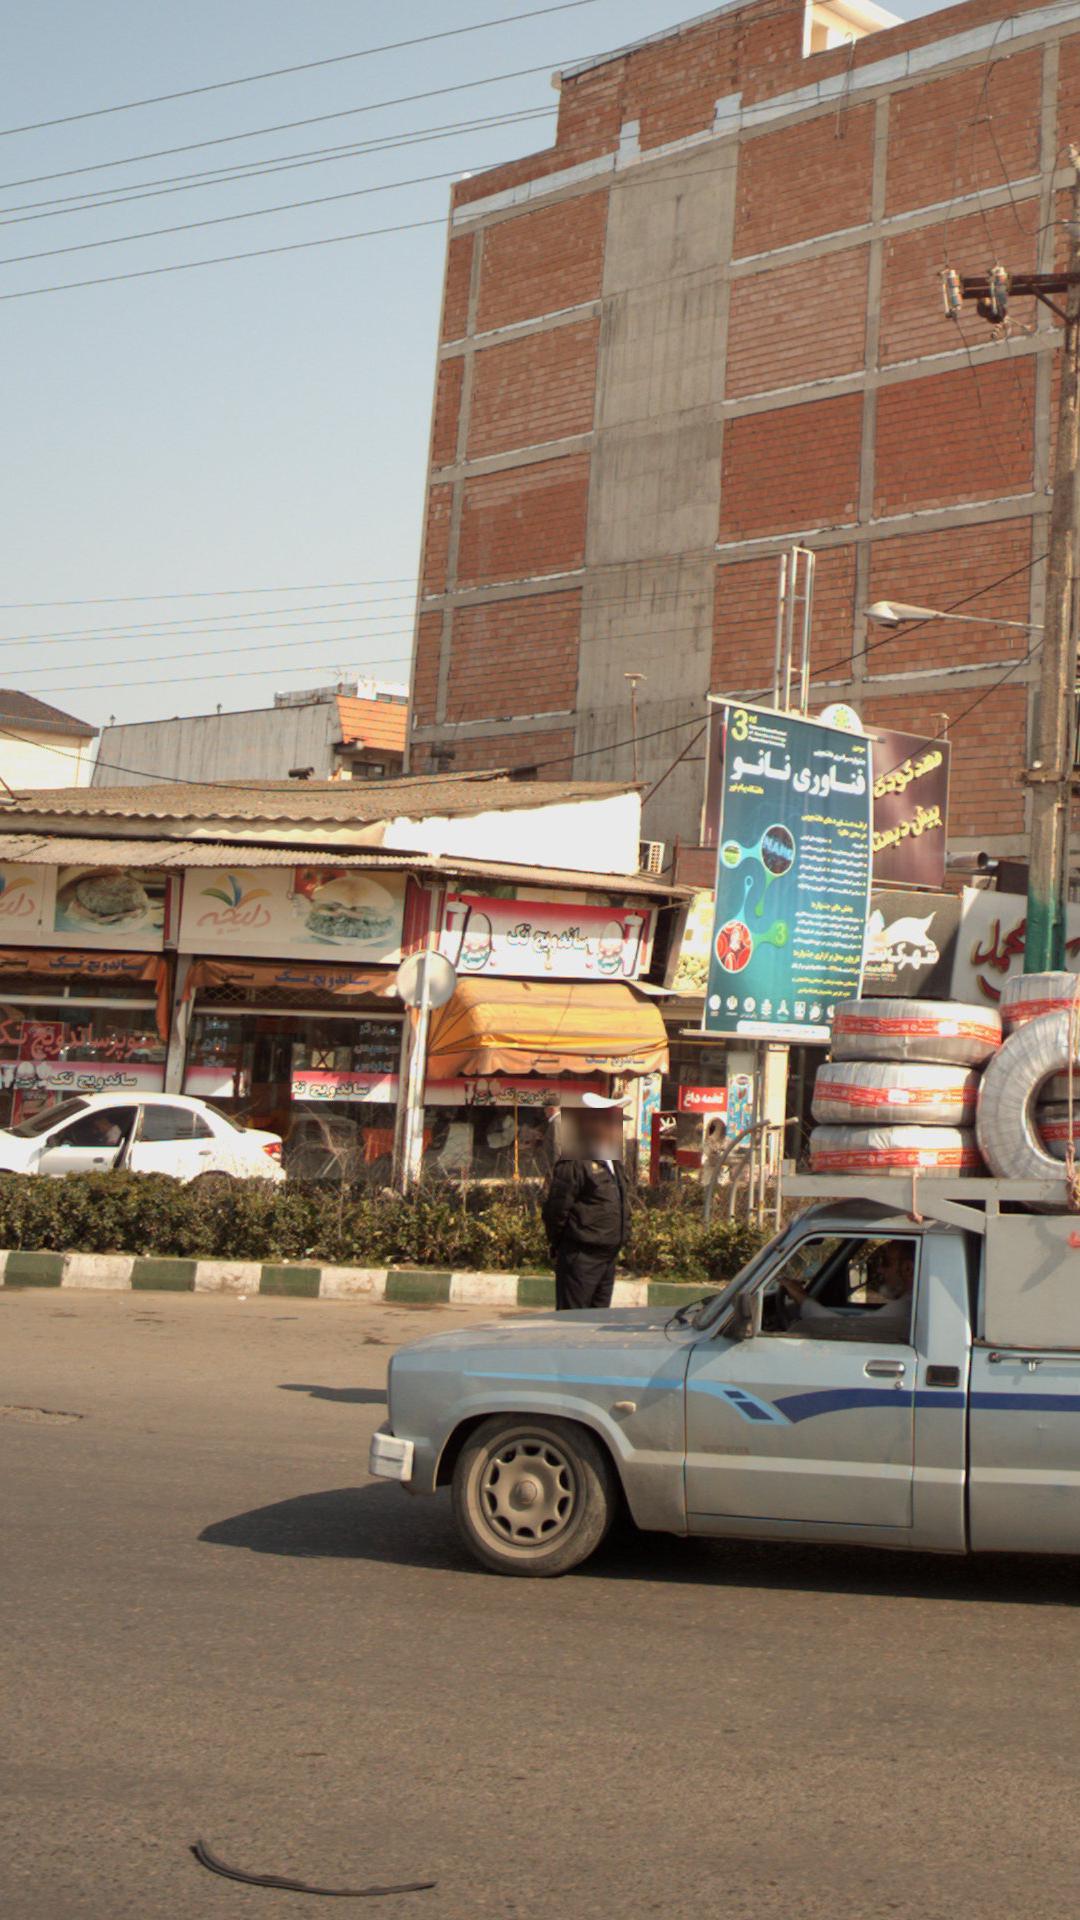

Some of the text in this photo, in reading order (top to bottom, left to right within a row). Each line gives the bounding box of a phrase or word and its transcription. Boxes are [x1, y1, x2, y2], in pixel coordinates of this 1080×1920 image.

[730, 750, 791, 780] نانو
[793, 765, 866, 797] فناوری
[532, 926, 593, 956] ساندویچ
[87, 957, 145, 972] ساندویچ
[51, 1071, 137, 1090] ساندویچ تک
[309, 1081, 368, 1099] ساندویچ
